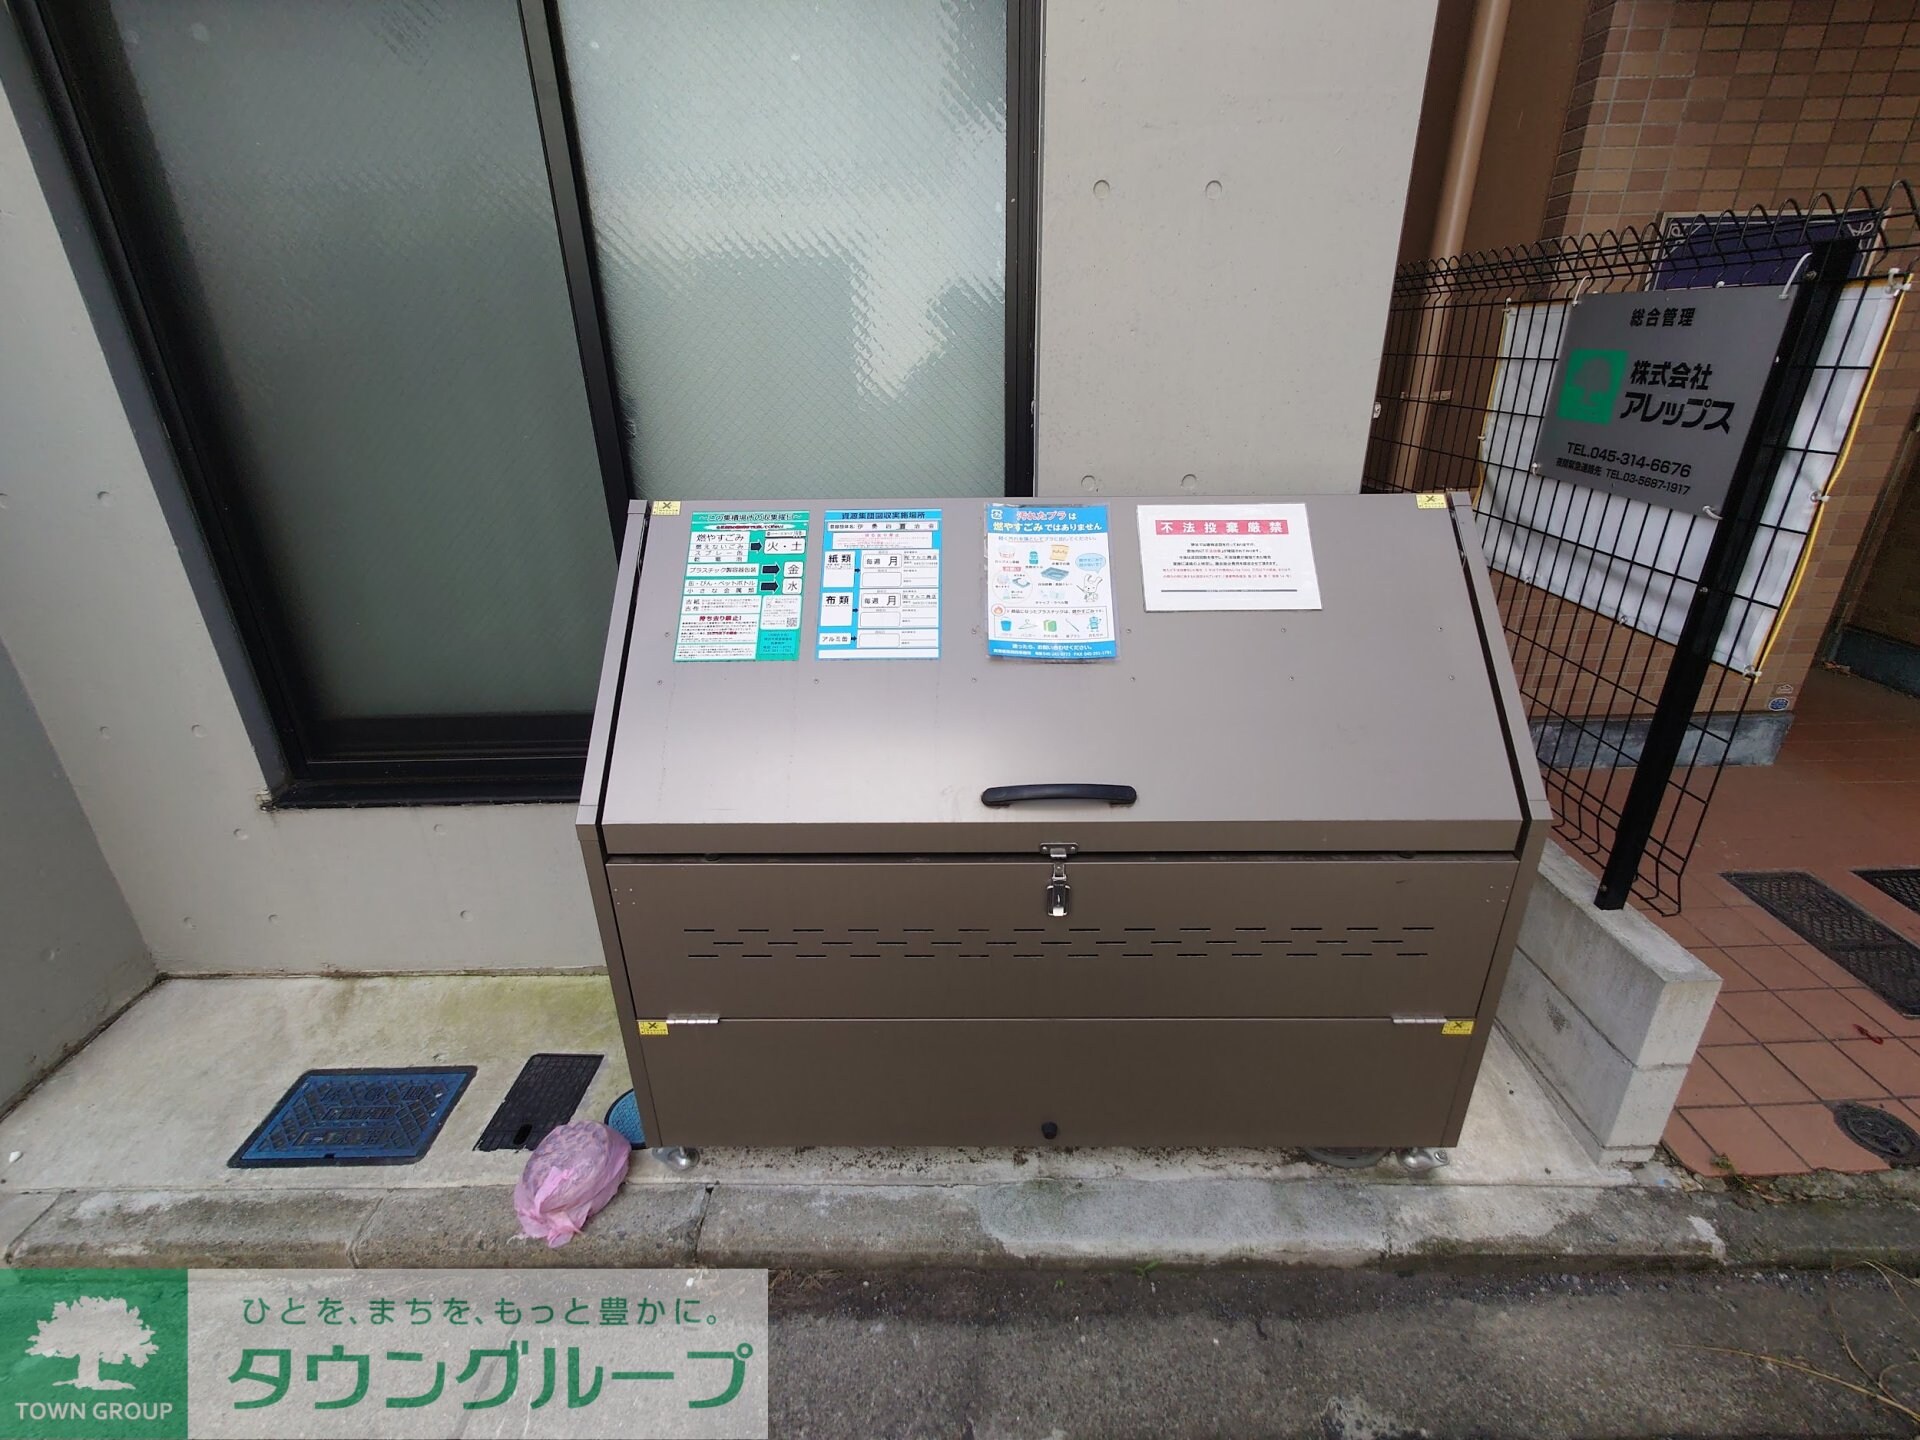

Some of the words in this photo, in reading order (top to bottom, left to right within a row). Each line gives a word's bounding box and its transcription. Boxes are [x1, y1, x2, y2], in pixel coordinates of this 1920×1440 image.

[1630, 307, 1695, 327] 総合管理
[1630, 360, 1713, 390] 株式会社
[1620, 391, 1735, 434] アレップス
[1567, 441, 1692, 478] TEL.045-314-6676
[1161, 521, 1283, 533] 不法投棄厳禁
[696, 533, 745, 542] 燃やすごみ
[767, 541, 803, 552] 火・土
[828, 554, 852, 563] 紙類
[888, 556, 898, 566] 月
[787, 564, 800, 575] 金
[787, 581, 798, 591] 水
[825, 596, 849, 605] 布類
[886, 595, 896, 606] 月
